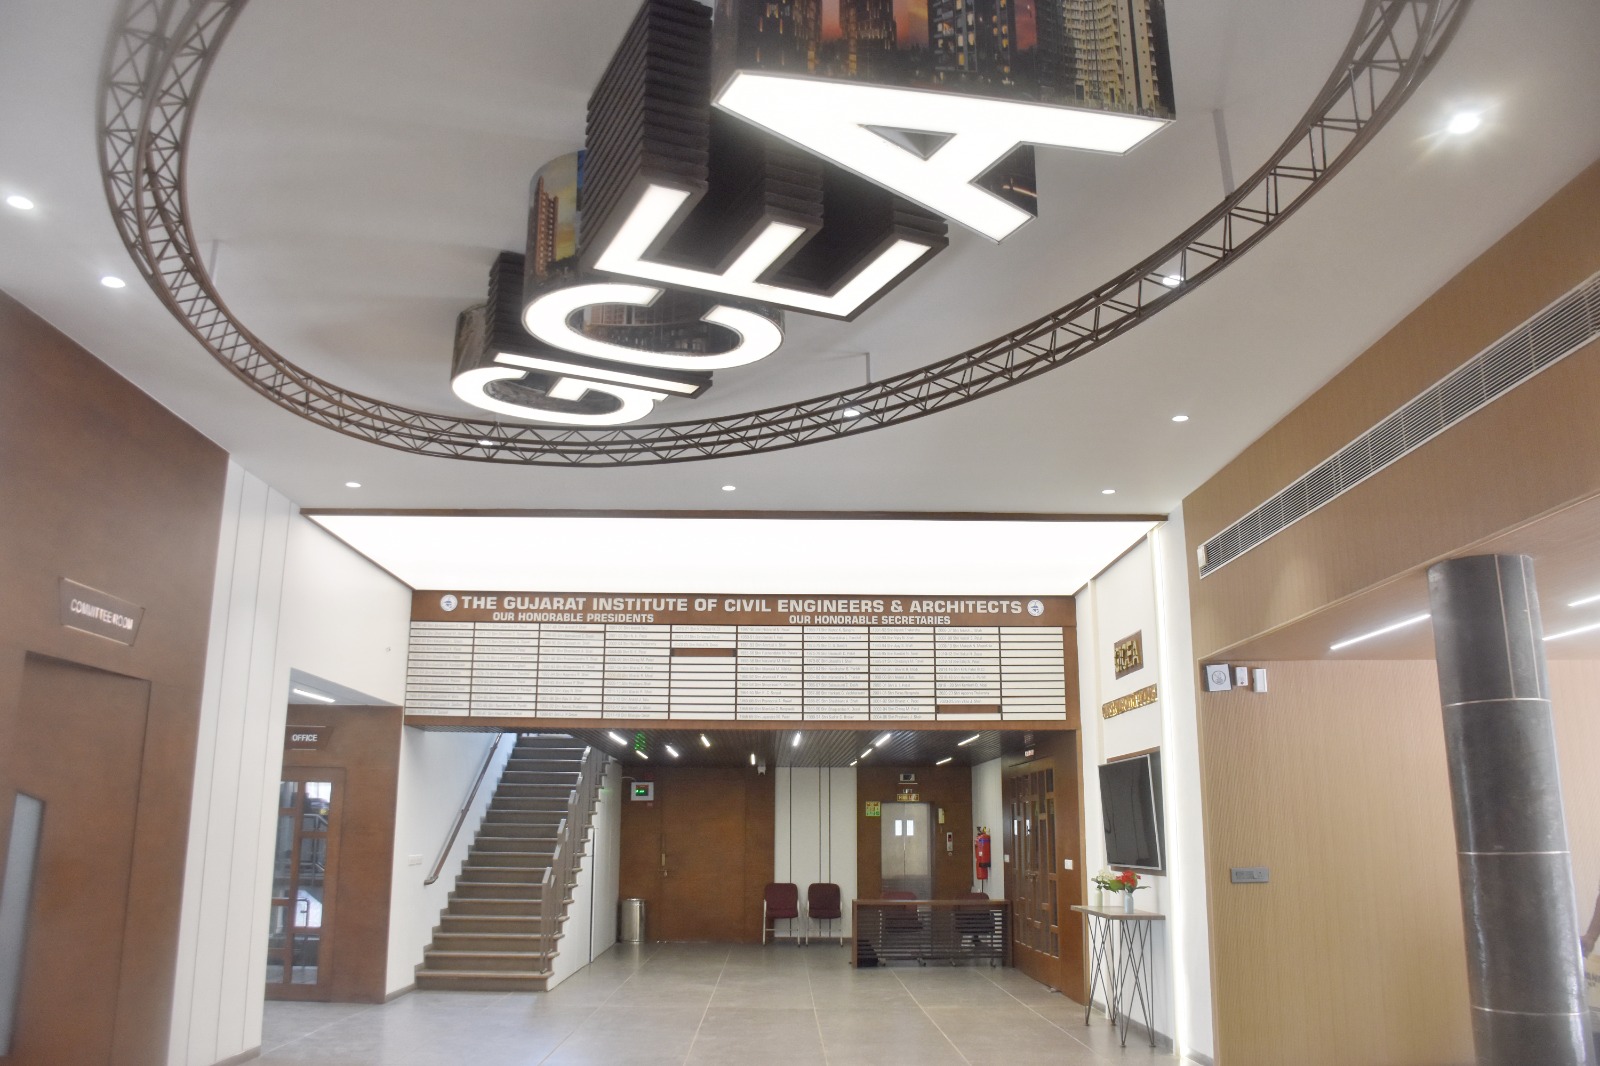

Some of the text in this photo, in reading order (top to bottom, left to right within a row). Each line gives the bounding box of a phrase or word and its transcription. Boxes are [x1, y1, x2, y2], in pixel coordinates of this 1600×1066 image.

[461, 595, 1022, 614] THE GUJARAT INSTITUTE OF CIVIL ENGINEERS & ARCHITECTS
[70, 599, 134, 630] COMMITTEE ROOM
[492, 611, 654, 623] OUR HONORABLE PRESIDENTS
[789, 614, 951, 625] OUR HONORABLE SECRETARIES
[292, 733, 318, 742] OFFICE
